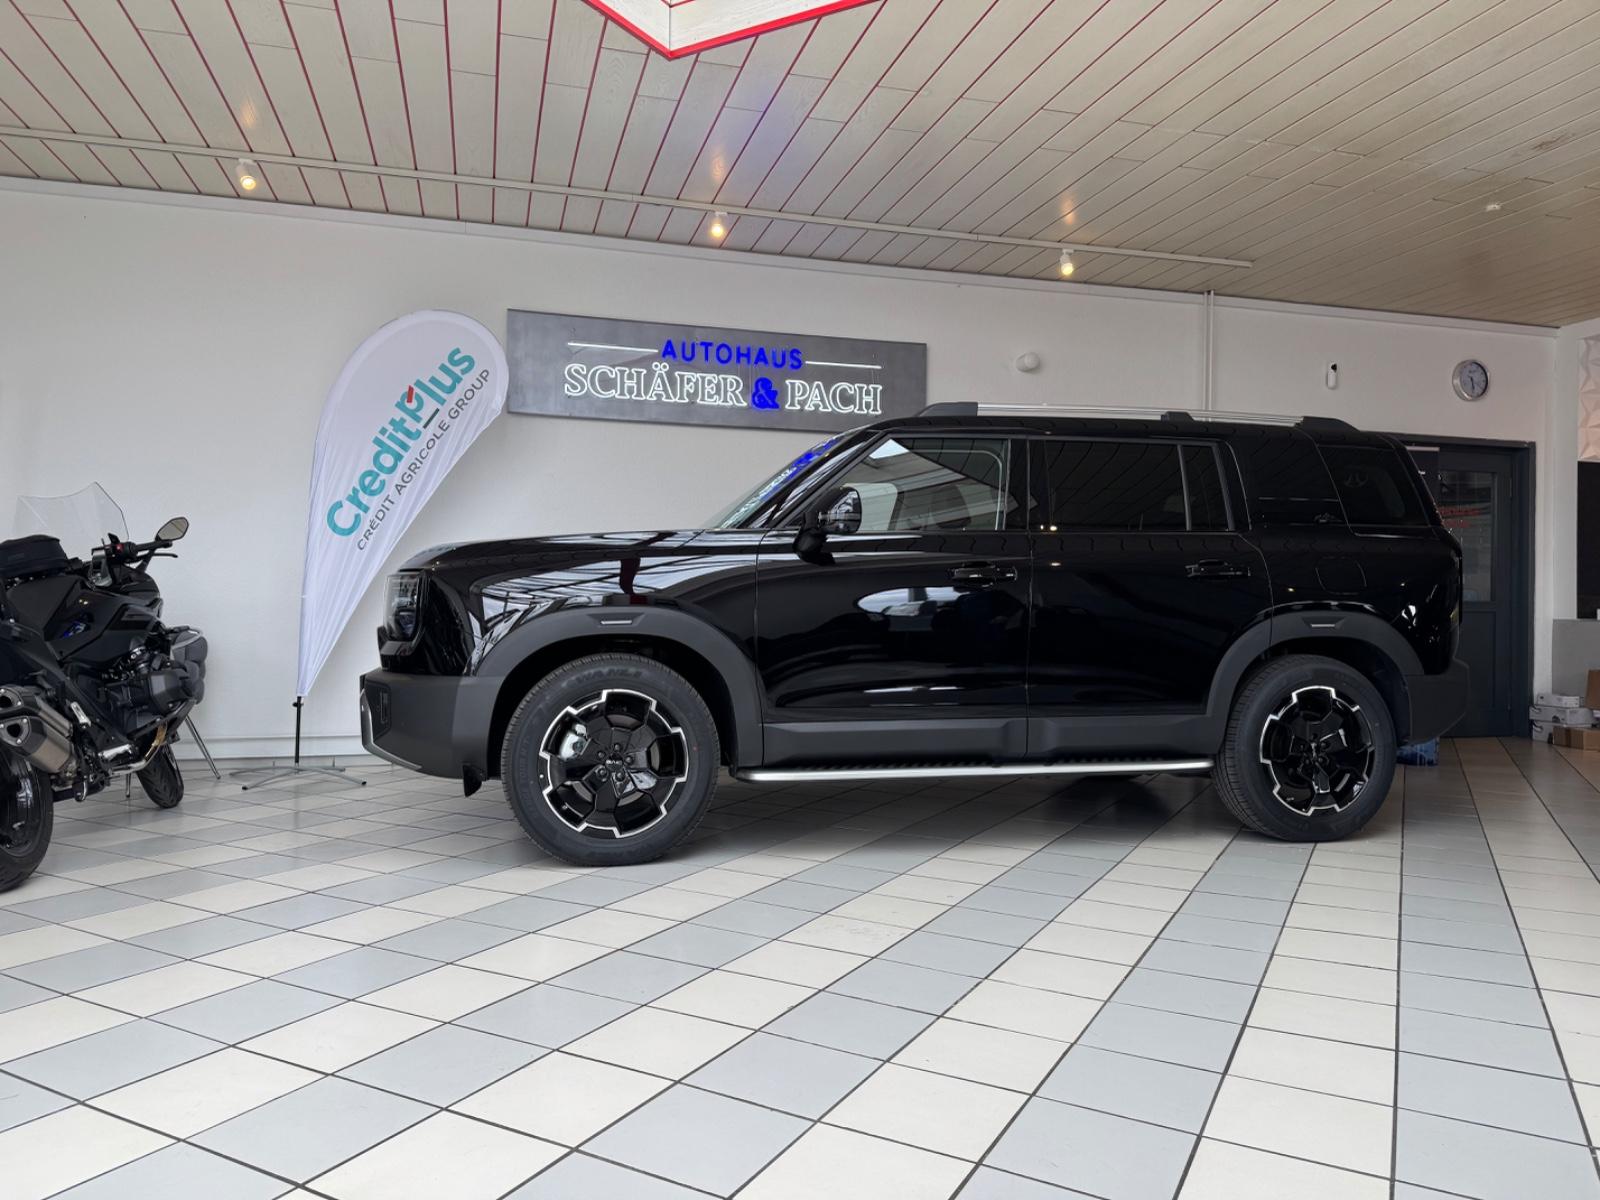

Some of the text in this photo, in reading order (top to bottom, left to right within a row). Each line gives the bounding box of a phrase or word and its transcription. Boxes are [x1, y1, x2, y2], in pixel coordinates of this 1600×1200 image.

[662, 339, 804, 370] AUTOHAUS
[564, 362, 882, 414] SCHÄFER & PACH
[357, 369, 490, 550] CRÉDIT AGRICOLE GROUP
